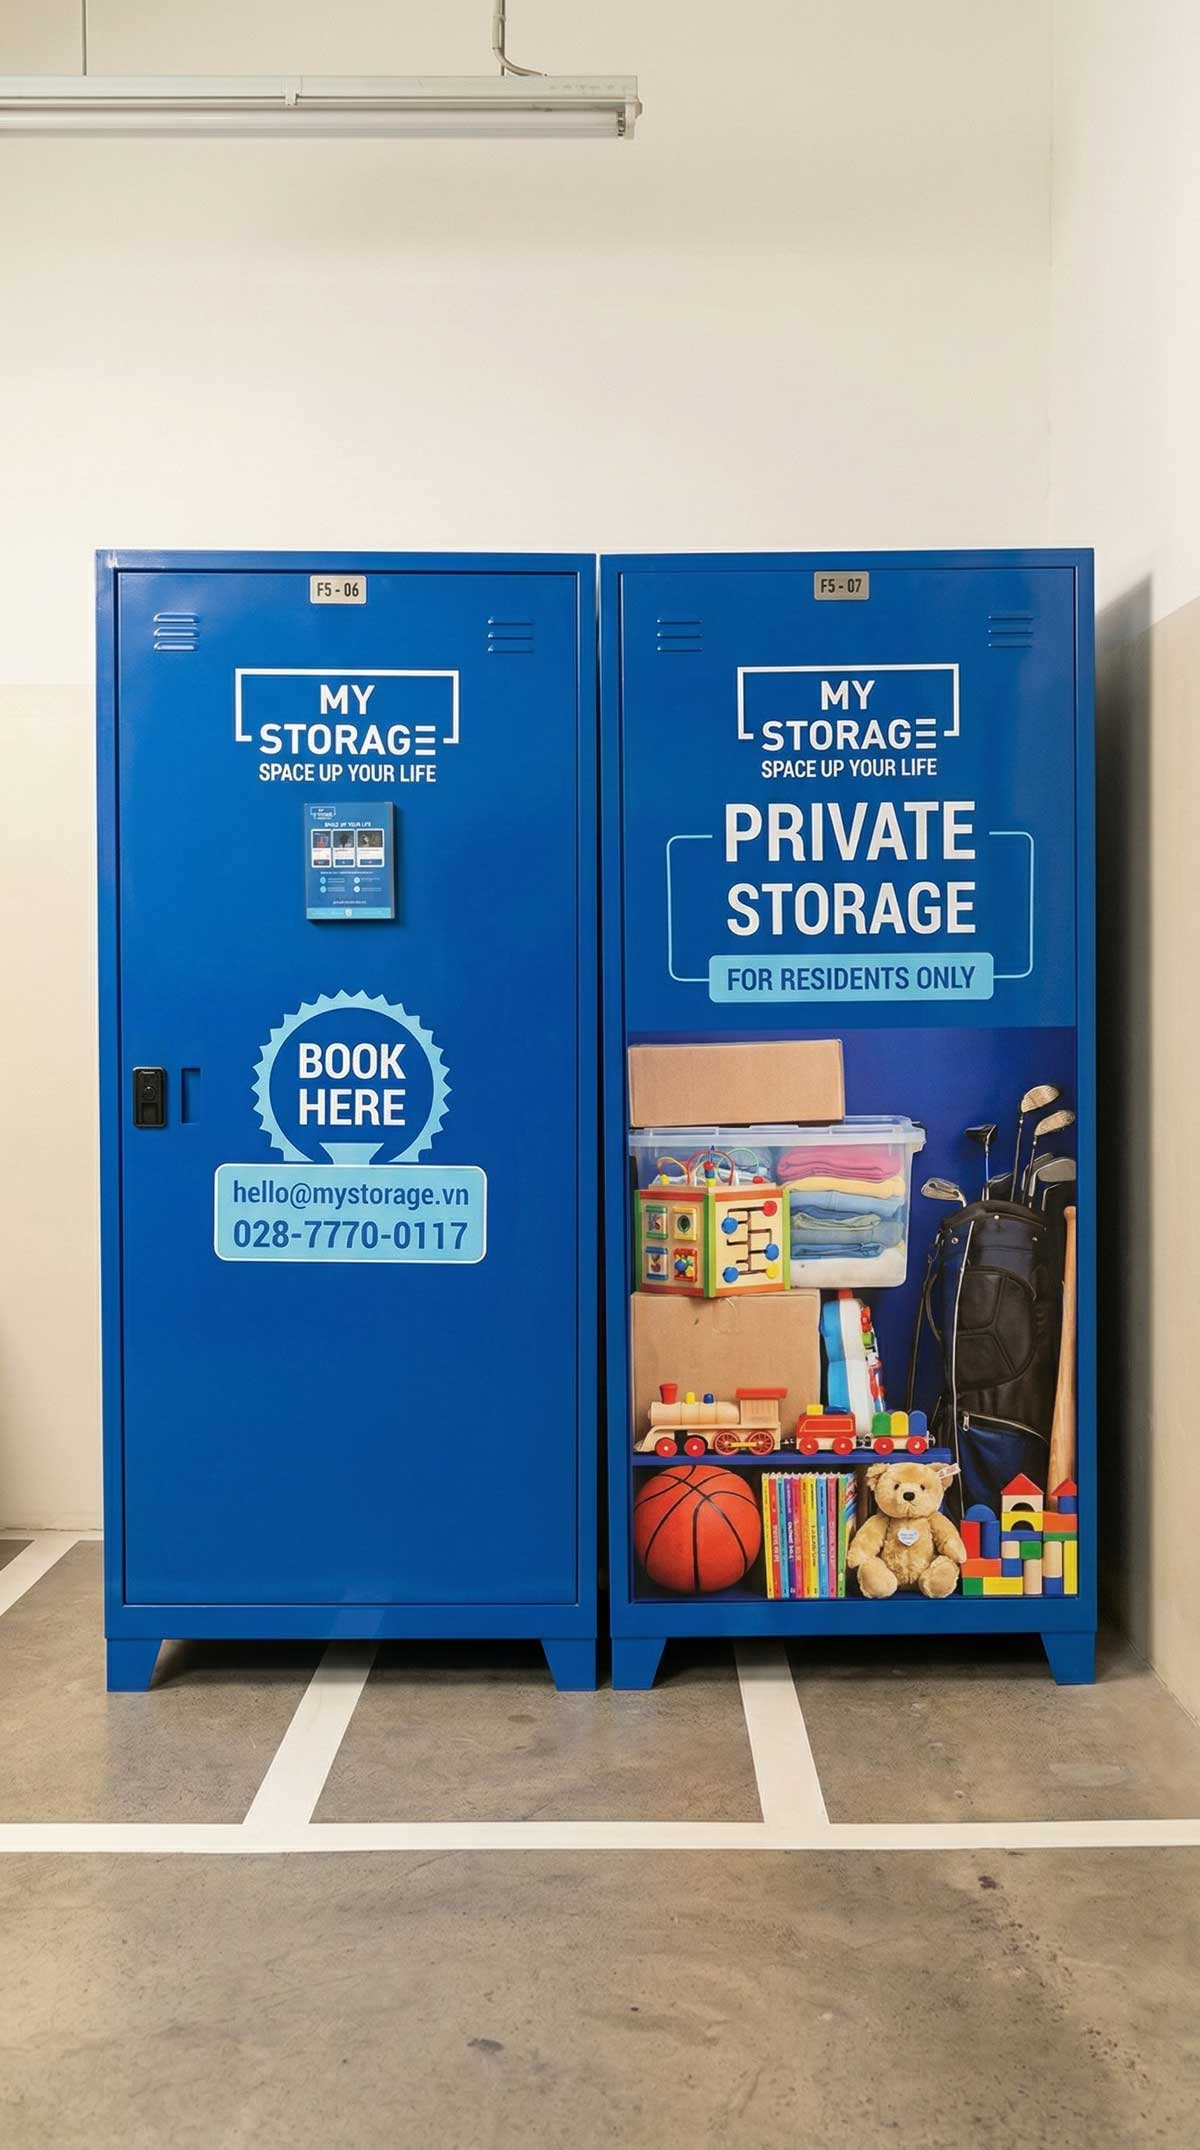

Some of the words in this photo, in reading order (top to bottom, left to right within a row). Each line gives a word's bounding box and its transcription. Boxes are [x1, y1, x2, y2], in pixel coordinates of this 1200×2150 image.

[317, 582, 332, 597] F5
[344, 582, 359, 597] 06
[820, 578, 836, 594] F5
[847, 578, 862, 593] 07
[320, 685, 375, 715] MY
[821, 681, 875, 710] MY
[259, 724, 436, 755] STORAGE
[761, 718, 937, 751] STORAGE
[259, 763, 314, 782] SPACE
[319, 764, 343, 782] UP
[348, 765, 395, 782] YOUR
[401, 765, 437, 782] LIFE
[761, 760, 817, 778] SPACE
[821, 760, 845, 777] UP
[849, 759, 896, 777] YOUR
[901, 758, 937, 776] LIFE
[725, 801, 976, 863] PRIVATE
[727, 882, 976, 935] STORAGE
[727, 967, 773, 991] FOR
[780, 967, 910, 991] RESIDENTS
[916, 966, 976, 990] ONLY
[298, 1043, 406, 1080] BOOK
[298, 1089, 406, 1126] HERE
[233, 1180, 469, 1210] hello@mystorage.vn
[233, 1220, 468, 1250] 028-7770-0117
